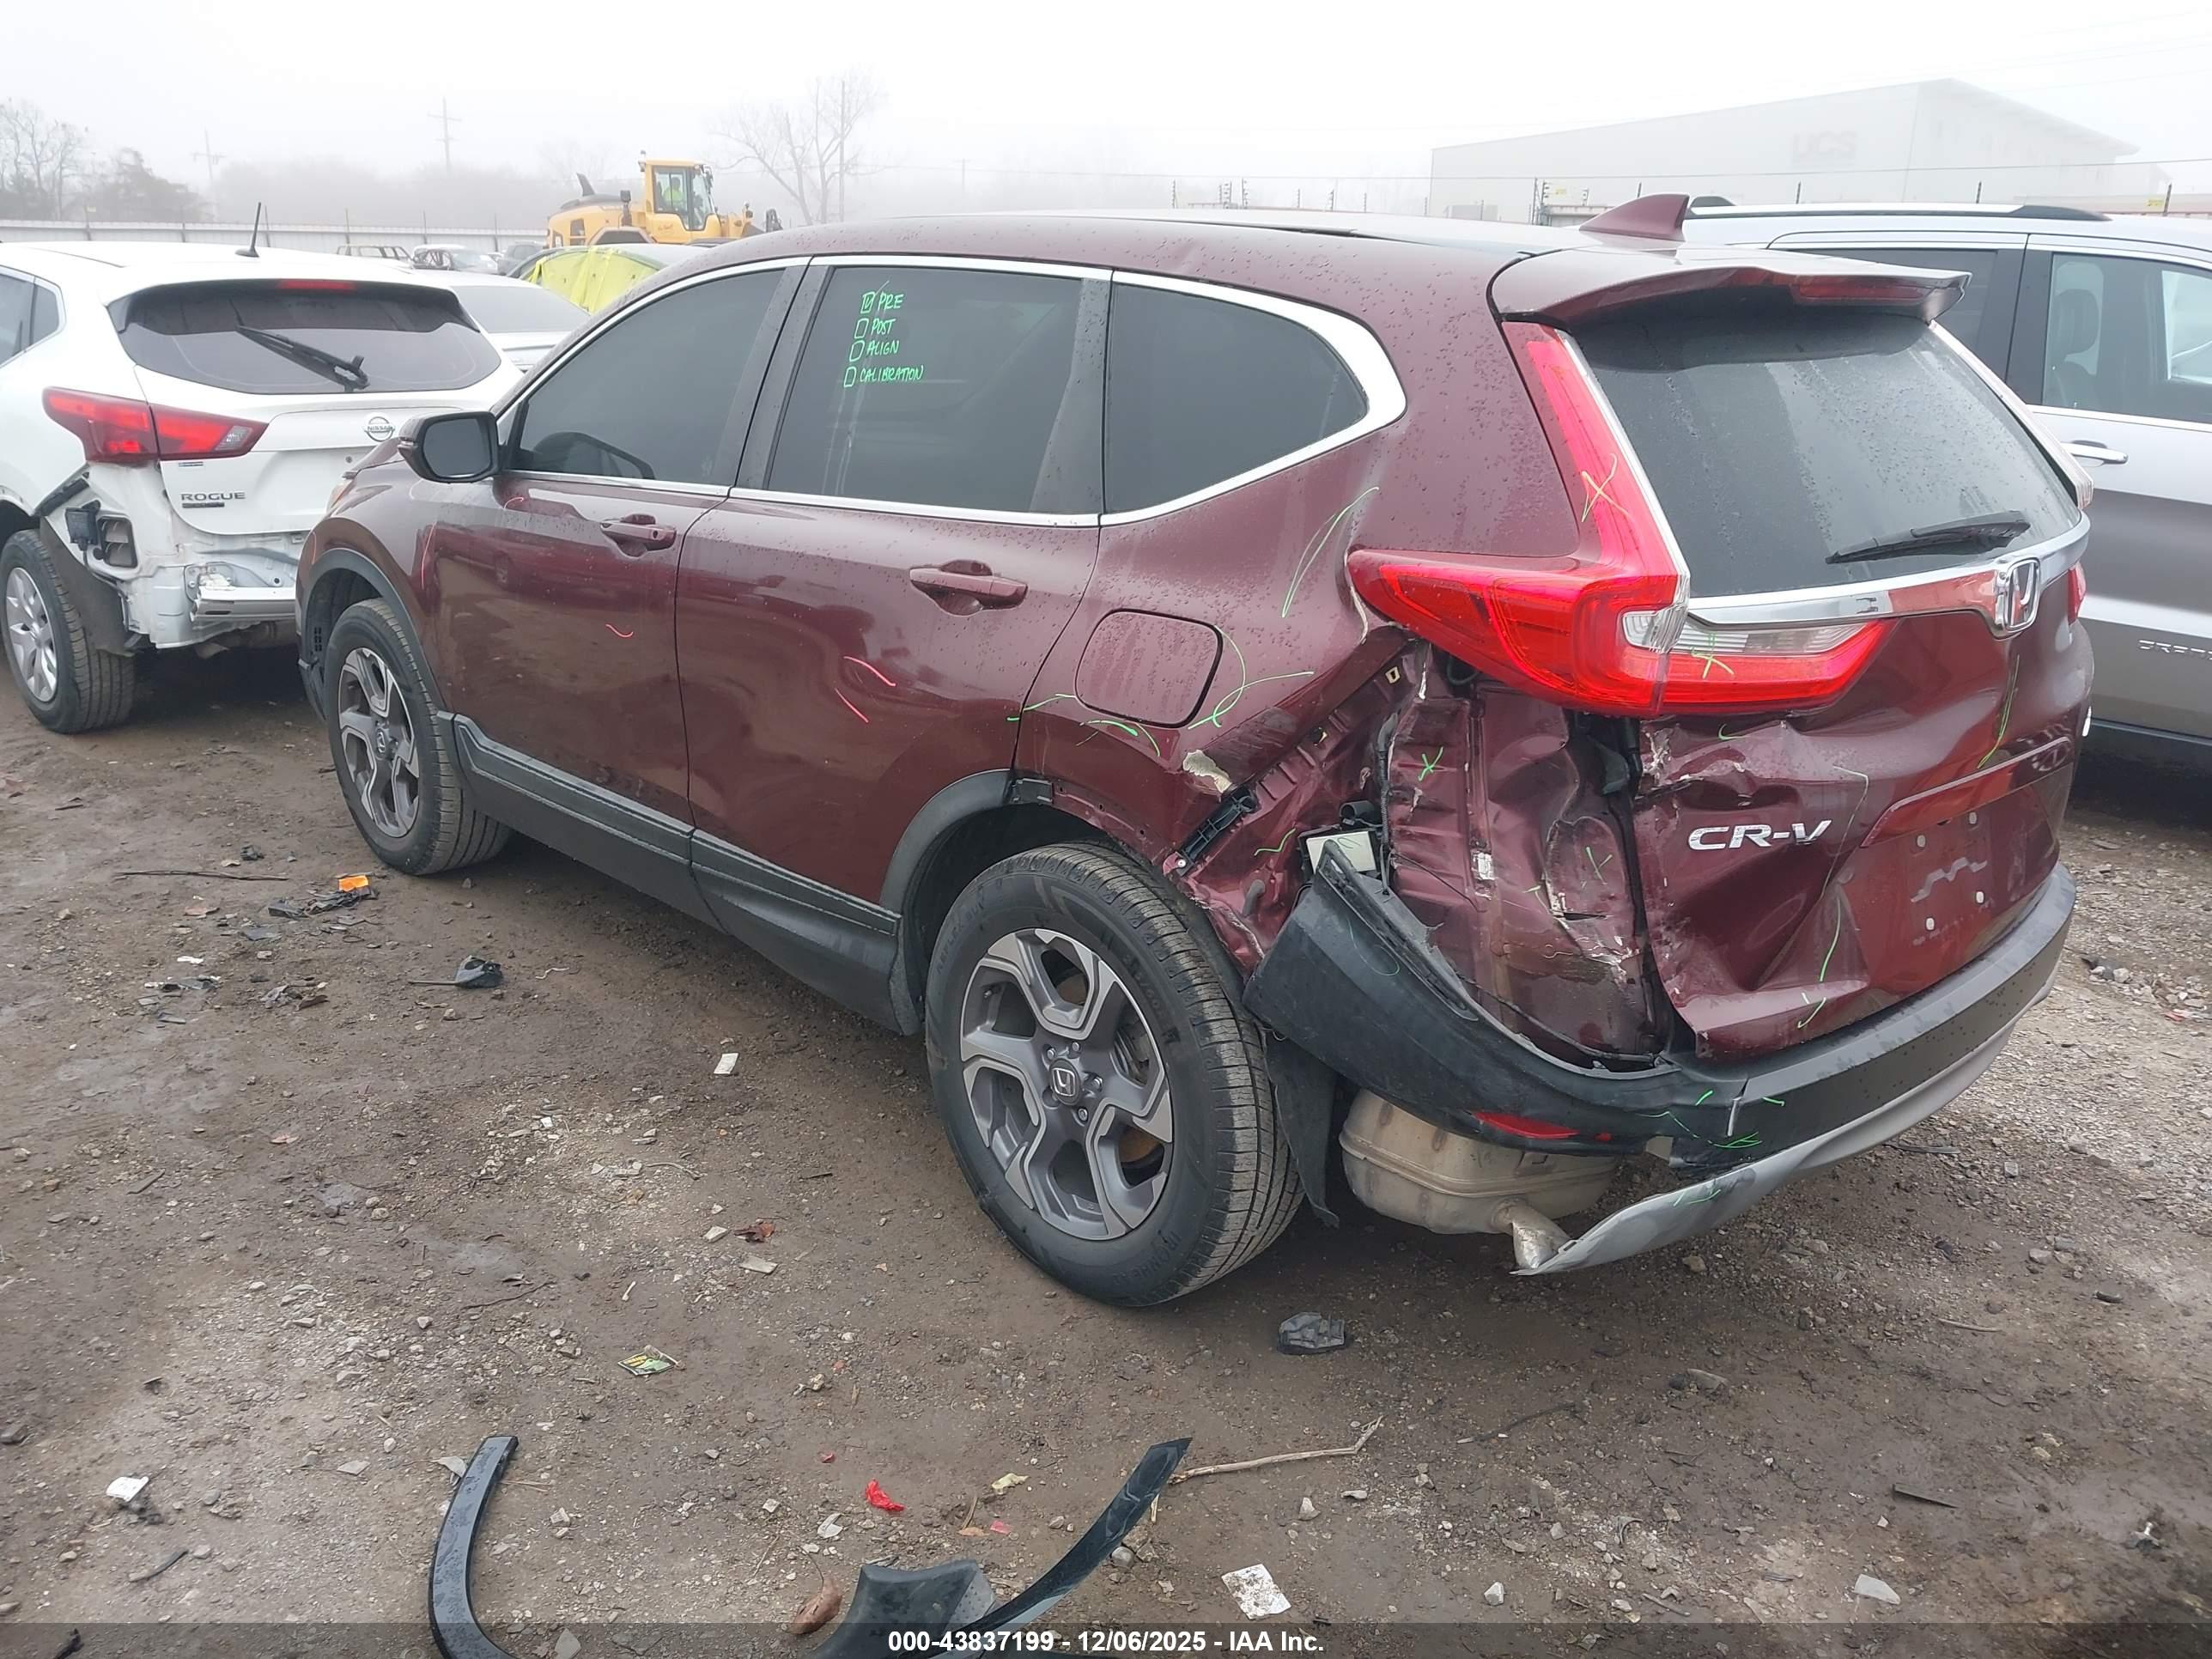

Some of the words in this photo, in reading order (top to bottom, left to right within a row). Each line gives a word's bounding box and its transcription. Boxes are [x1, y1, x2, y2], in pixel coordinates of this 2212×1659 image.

[878, 291, 904, 310] PRE
[871, 318, 896, 335] POST
[866, 339, 900, 356] ALIGN
[860, 364, 924, 382] CALIBRATION
[180, 492, 246, 501] ROGUE
[1688, 819, 1832, 851] CR-V
